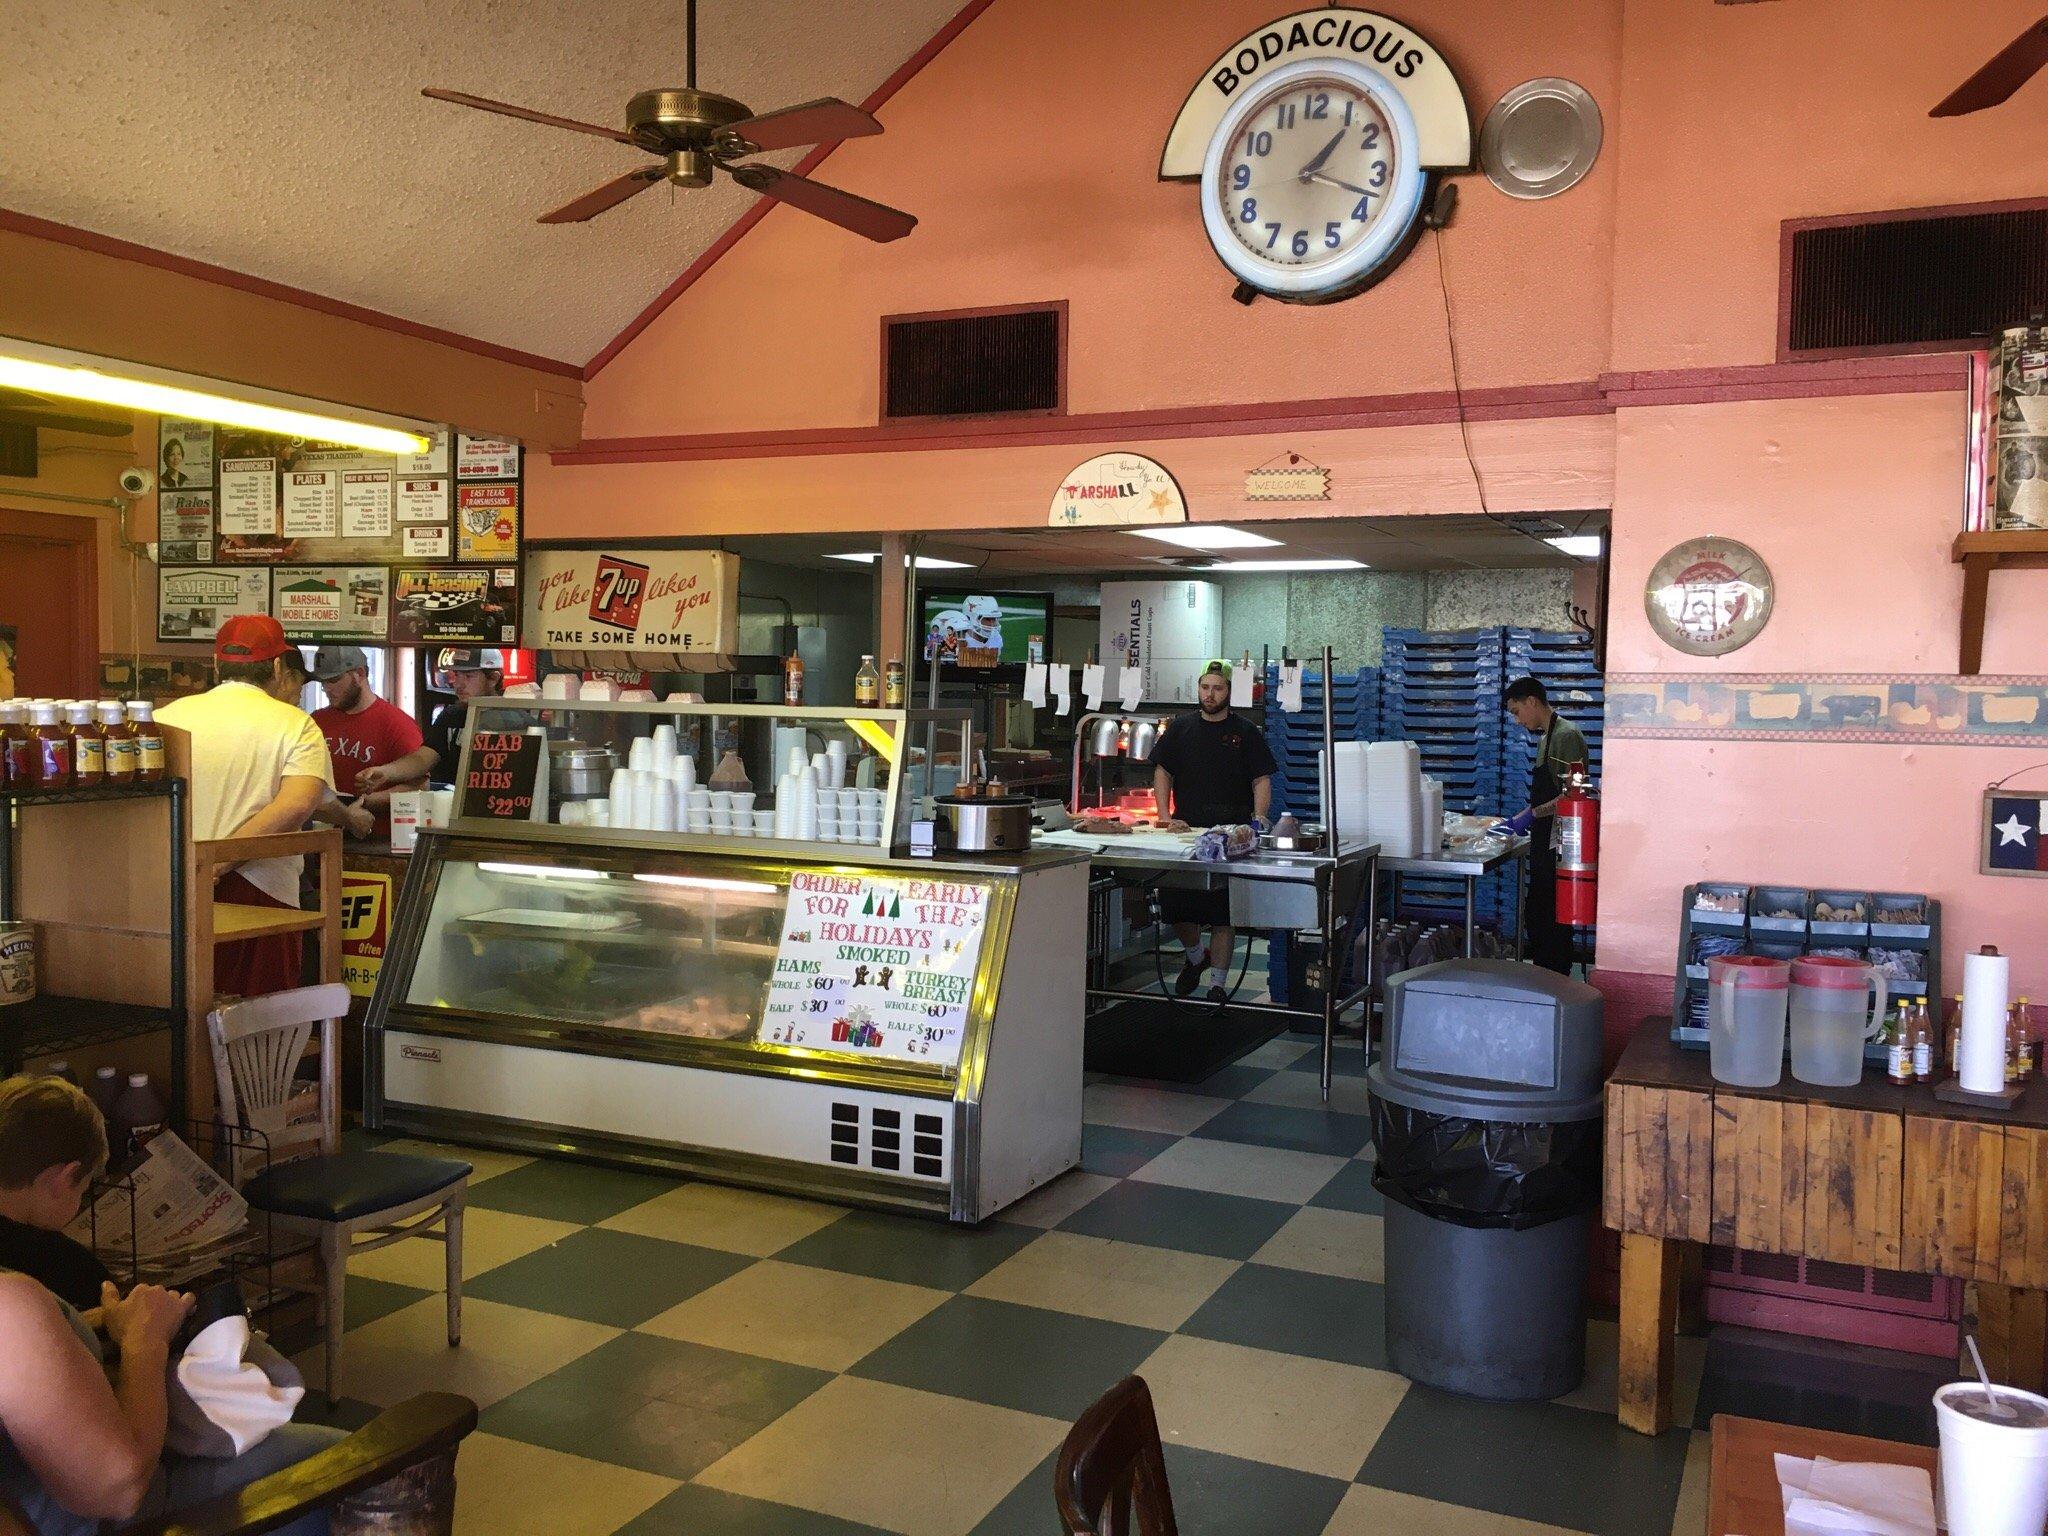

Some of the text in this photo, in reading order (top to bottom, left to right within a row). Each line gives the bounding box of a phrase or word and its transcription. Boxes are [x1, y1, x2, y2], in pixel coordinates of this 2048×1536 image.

[1211, 17, 1424, 97] BODACIOUS
[1304, 93, 1329, 119] 12
[1344, 101, 1353, 126] 1
[1277, 104, 1295, 129] 11
[1246, 131, 1272, 157] 10
[1361, 123, 1379, 149] 2
[1233, 165, 1250, 190] 9
[1368, 161, 1387, 187] 3
[1240, 198, 1256, 223] 8
[1351, 197, 1368, 222] 4
[1264, 223, 1281, 249] 7
[1291, 230, 1308, 256] 6
[1324, 223, 1341, 248] 5
[225, 461, 271, 472] SANDWICHES
[296, 475, 322, 485] PLATES
[412, 482, 432, 490] SIDES
[1254, 480, 1306, 490] WELCOME
[466, 497, 510, 506] TRANSMISSIONS
[470, 488, 506, 498] EAST TEXAS
[413, 529, 438, 538] DRINKS
[1697, 551, 1726, 560] MILK
[164, 579, 241, 594] CAMPBELL
[538, 568, 575, 611] you
[553, 583, 591, 613] like
[645, 571, 699, 602] likes
[290, 594, 331, 605] MARSHALL
[282, 608, 339, 620] MOBILE HOMES
[671, 589, 712, 630] you
[547, 630, 692, 646] TAKE SOME HOME
[1675, 627, 1735, 643] ICE CREAM
[473, 733, 523, 752] SLAB
[483, 753, 508, 770] OF
[468, 771, 513, 789] RIBS
[792, 873, 984, 904] ORDER EARLY
[804, 896, 968, 928] FOR THE
[819, 921, 934, 950] HOLIDAYS
[358, 942, 382, 956] Often
[836, 945, 911, 965] SMOKED
[776, 958, 822, 974] HAMS
[771, 979, 801, 990] WHOLE
[905, 970, 972, 992] TURKEY
[902, 985, 968, 1005] BREAST
[769, 1003, 794, 1013] HALF
[884, 1000, 918, 1013] WHOLE
[887, 1020, 915, 1032] HALF
